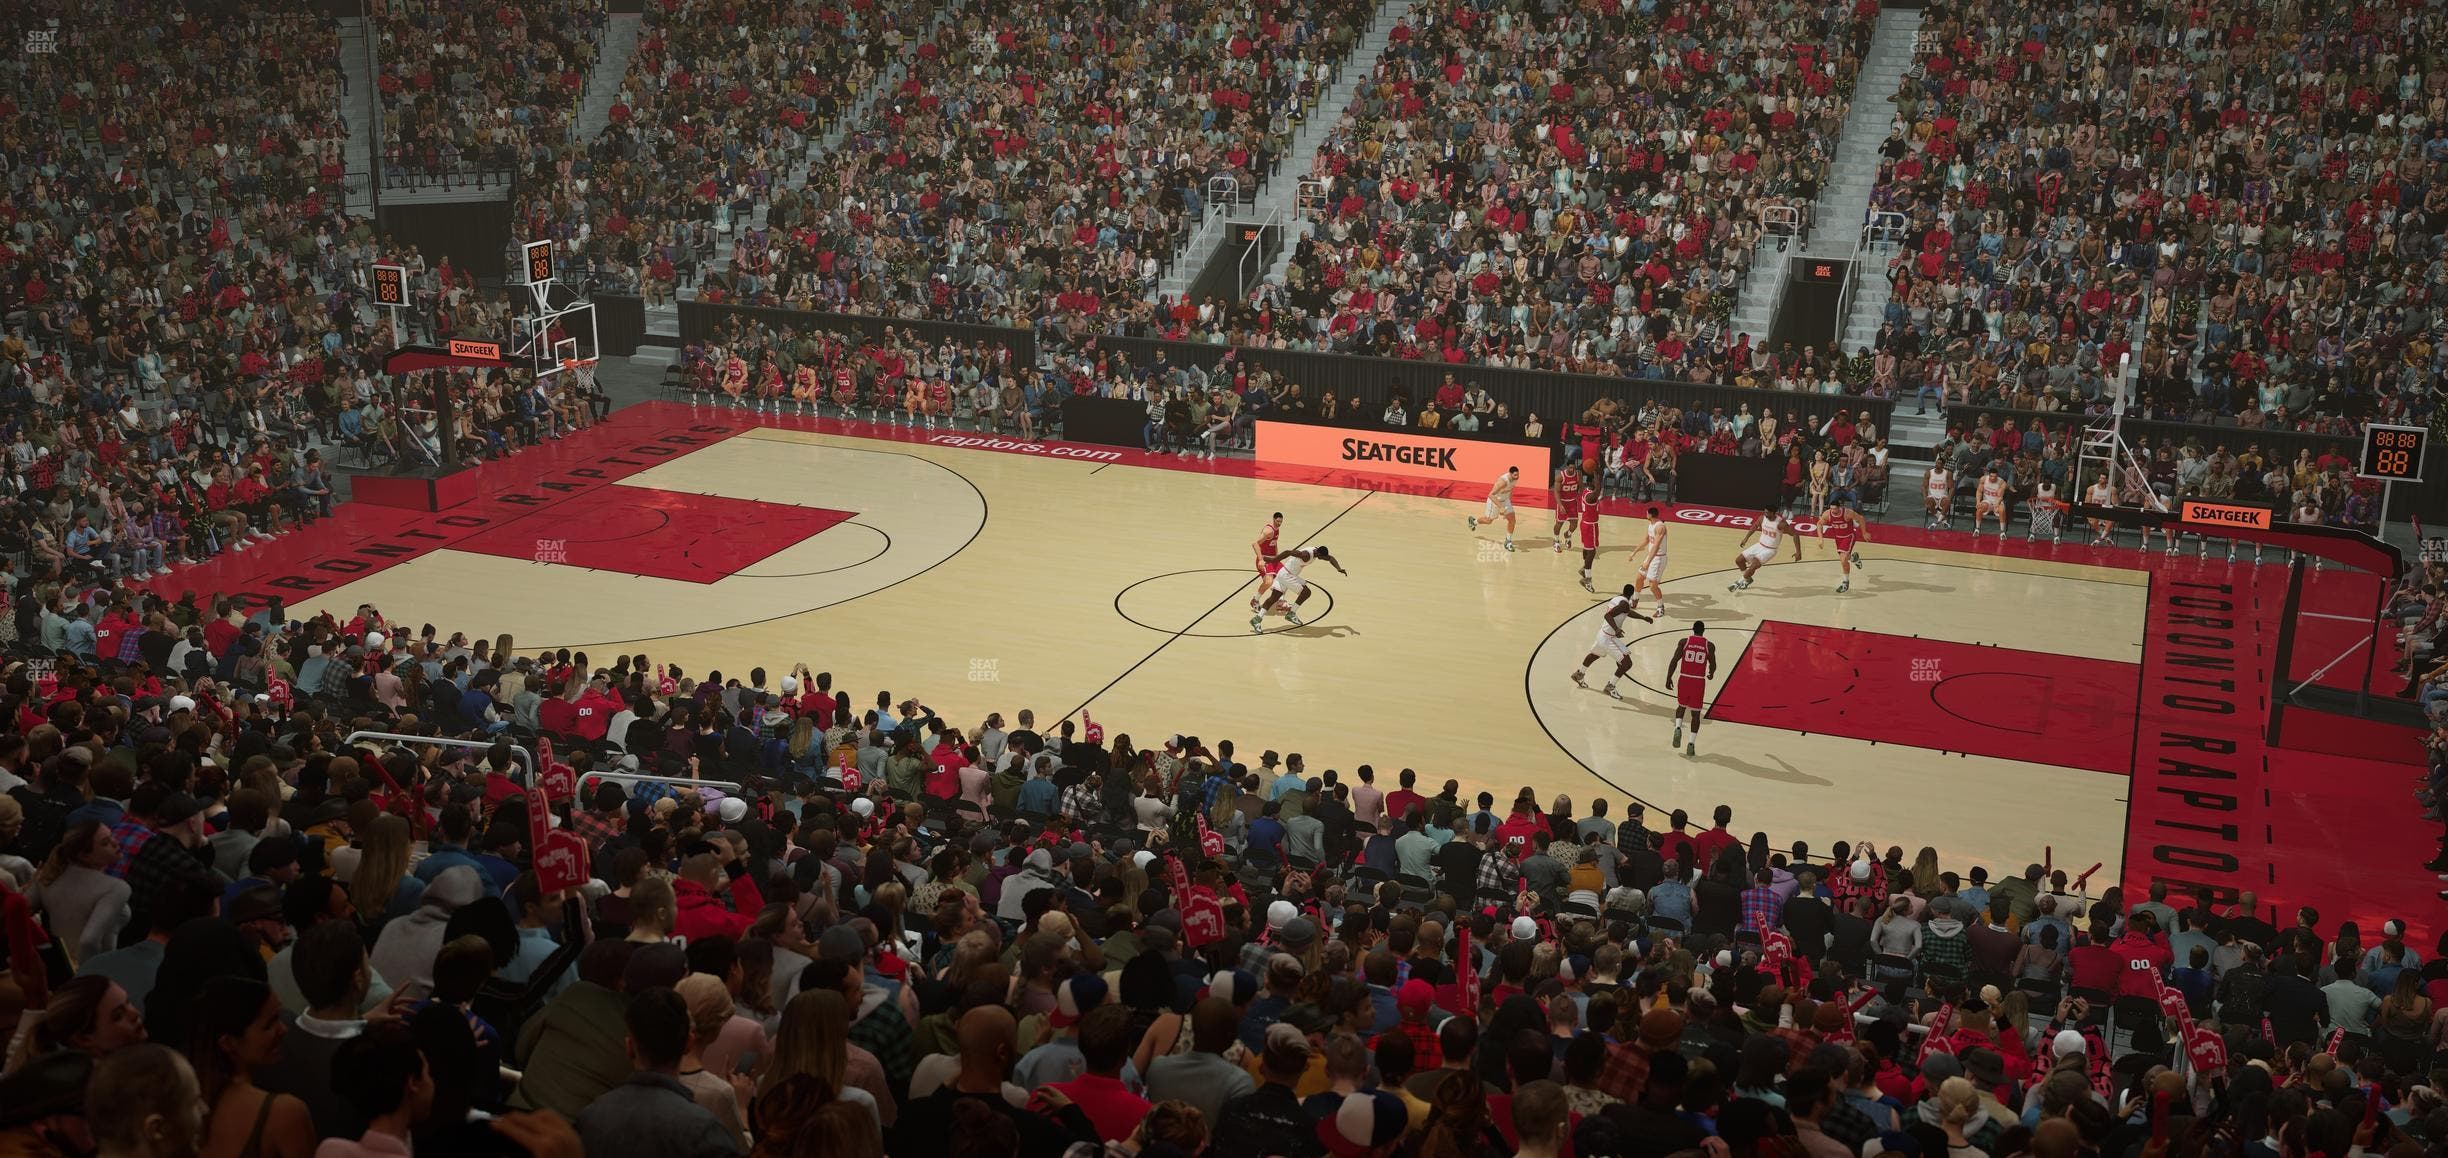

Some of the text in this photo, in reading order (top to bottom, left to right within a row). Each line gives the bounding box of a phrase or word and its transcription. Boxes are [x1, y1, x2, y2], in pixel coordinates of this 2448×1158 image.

[377, 271, 397, 282] 88 88
[535, 259, 548, 279] 88
[381, 284, 397, 301] 88
[455, 343, 495, 357] SEATGEEK
[930, 434, 1122, 461] raptors.com
[2377, 431, 2416, 448] 88 88
[1342, 437, 1456, 472] SEATGEEK
[2377, 449, 2408, 474] 88
[228, 424, 735, 609] ORONTO RAPTORS
[2192, 508, 2259, 525] SEATGEEK
[97, 630, 110, 638] 00
[1685, 650, 1706, 664] 00
[579, 707, 592, 716] 00
[2152, 582, 2239, 905] TORONTO RAPTOR
[2131, 959, 2150, 970] 00
